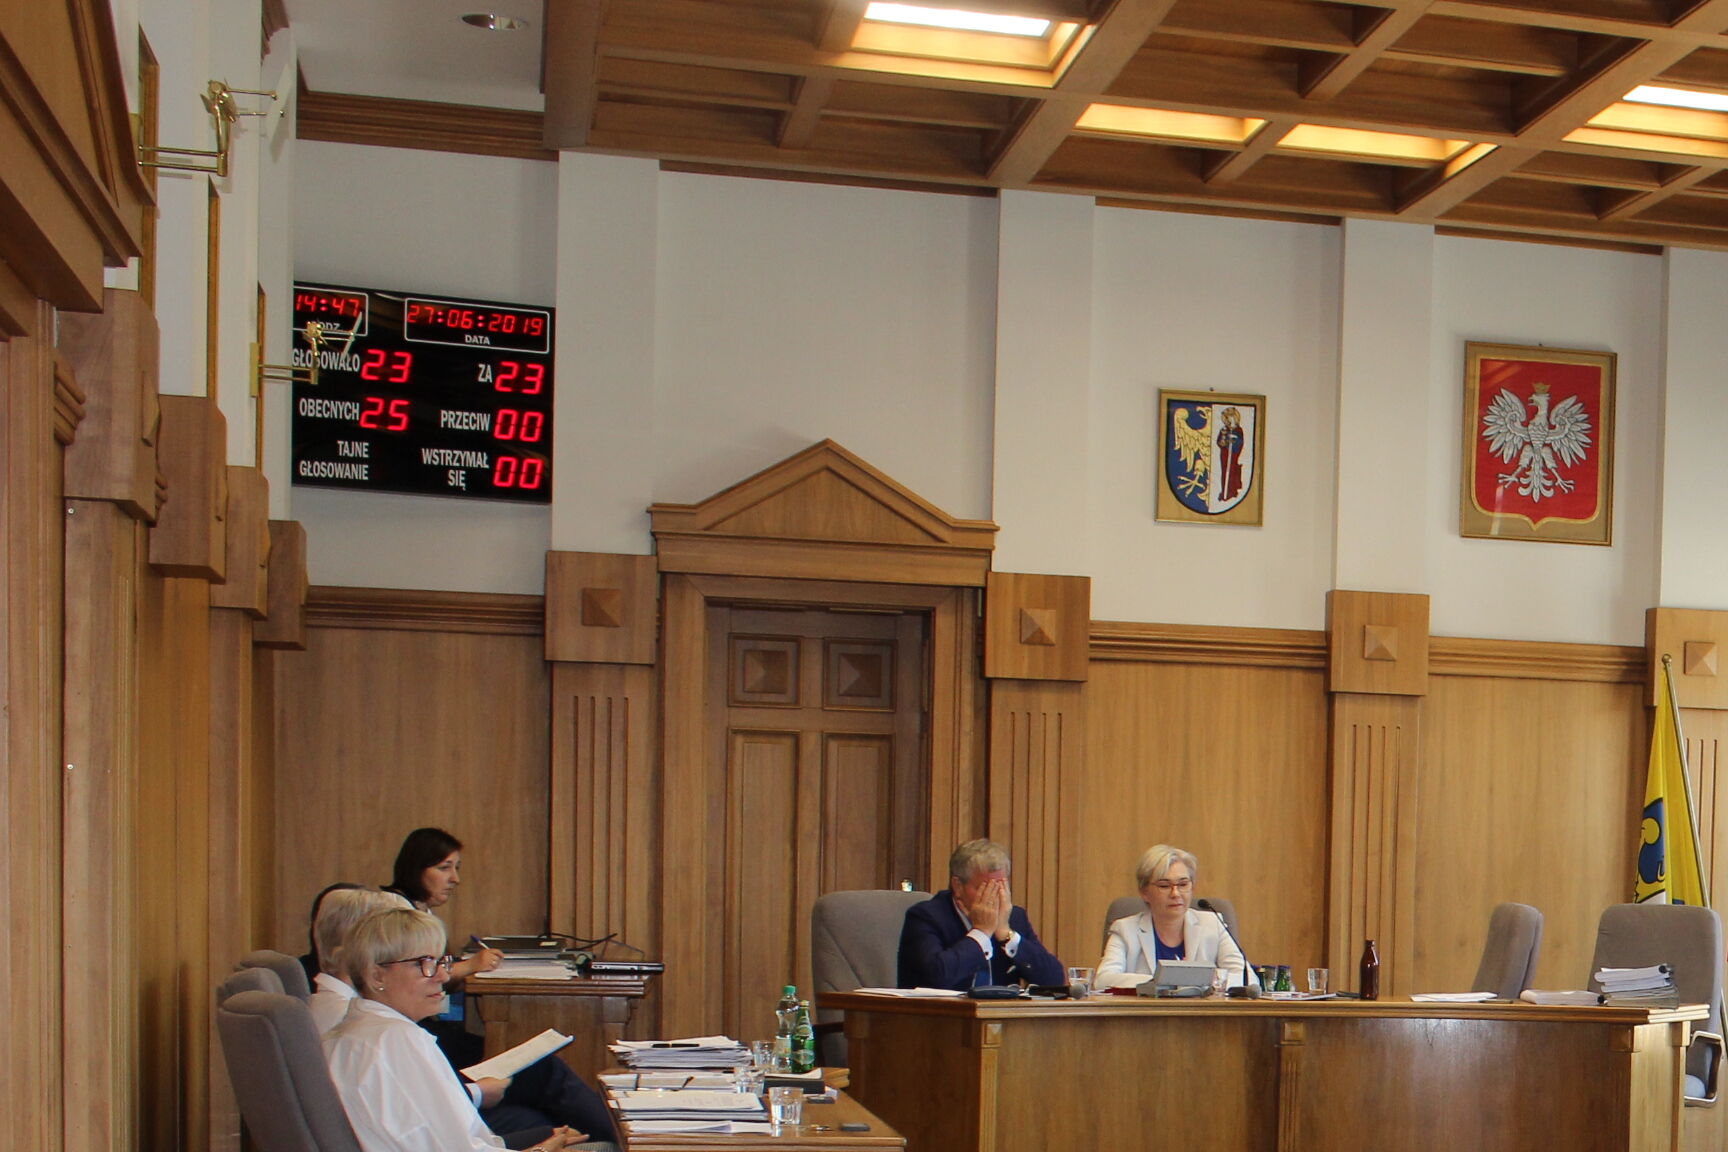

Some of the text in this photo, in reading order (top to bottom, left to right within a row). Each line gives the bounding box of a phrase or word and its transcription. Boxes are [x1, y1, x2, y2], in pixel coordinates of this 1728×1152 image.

[295, 295, 361, 317] 14:47
[406, 304, 544, 336] 27:06:2019
[464, 334, 491, 345] DATA
[361, 348, 413, 383] 23
[478, 361, 545, 395] ZA 23
[299, 397, 411, 431] OBECNYCH 25
[440, 408, 544, 442] PRZECIW 00
[337, 440, 370, 458] TAJNE
[299, 460, 369, 480] GŁOSOWANIE
[421, 447, 544, 489] WSTRZYMAŁ 00
[447, 469, 467, 491] SIĘ
